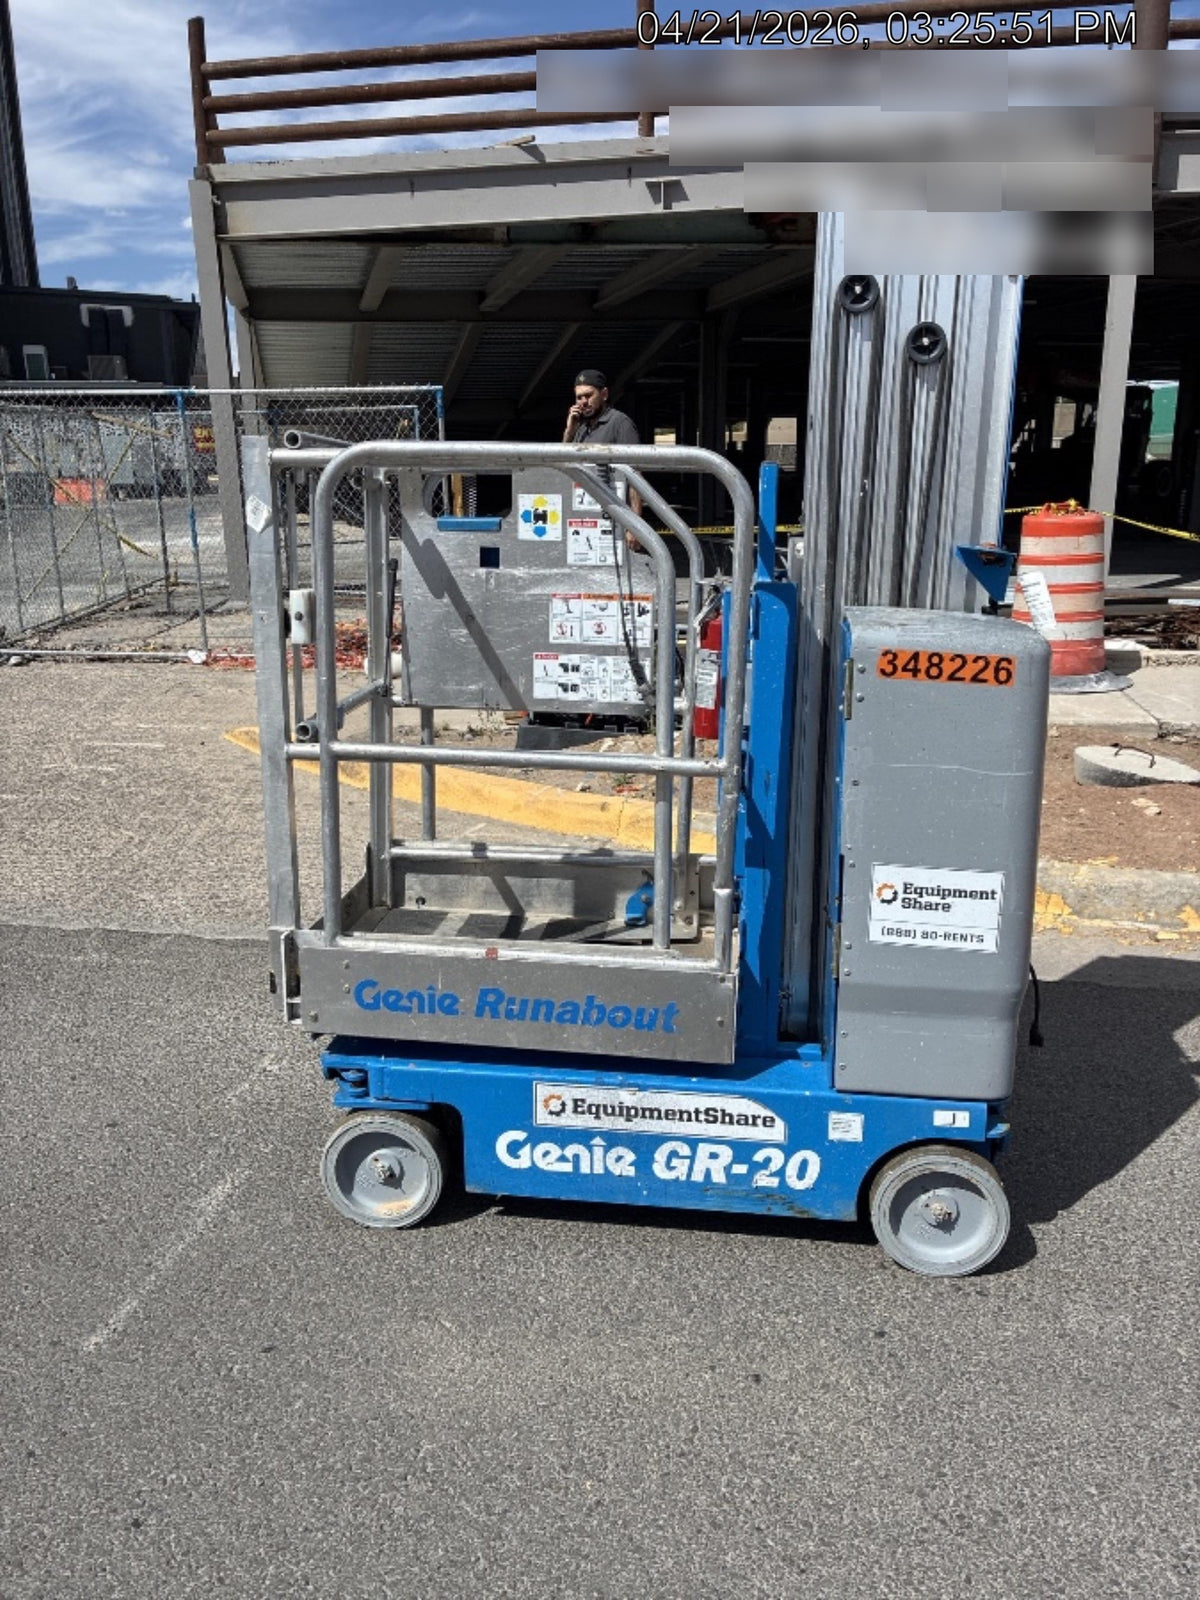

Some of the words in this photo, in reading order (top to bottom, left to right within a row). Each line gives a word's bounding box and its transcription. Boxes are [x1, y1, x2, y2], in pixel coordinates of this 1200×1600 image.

[880, 649, 1014, 685] 348226
[901, 896, 952, 913] Share
[902, 882, 997, 900] Equipment
[354, 979, 460, 1015] Genie
[474, 986, 680, 1034] Runabout
[571, 1098, 776, 1129] EquipmentShare
[495, 1129, 636, 1177] Genie
[651, 1141, 823, 1192] GR-20
